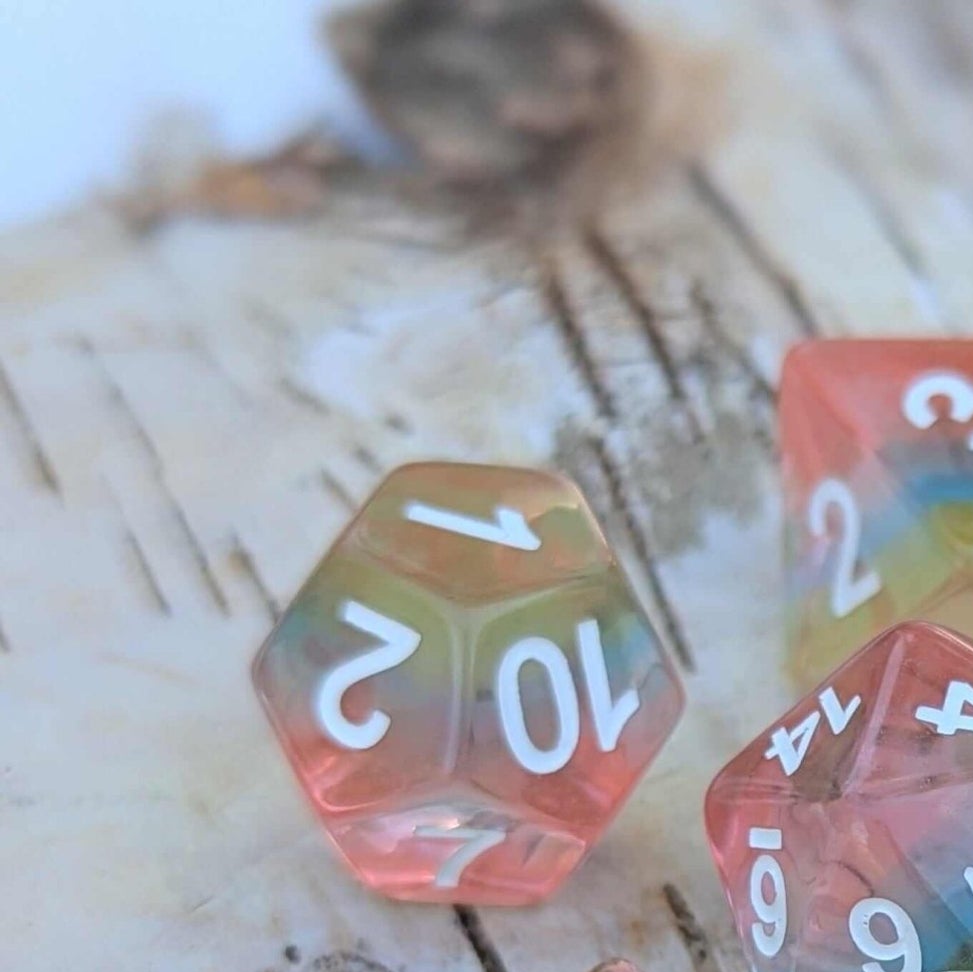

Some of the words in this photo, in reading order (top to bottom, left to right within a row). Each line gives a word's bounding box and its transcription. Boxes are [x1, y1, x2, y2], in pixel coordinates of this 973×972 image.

[403, 502, 541, 551] 1
[809, 477, 882, 618] 2
[316, 599, 422, 750] 2
[497, 618, 640, 775] 10
[764, 686, 861, 776] 14
[412, 825, 506, 889] 7
